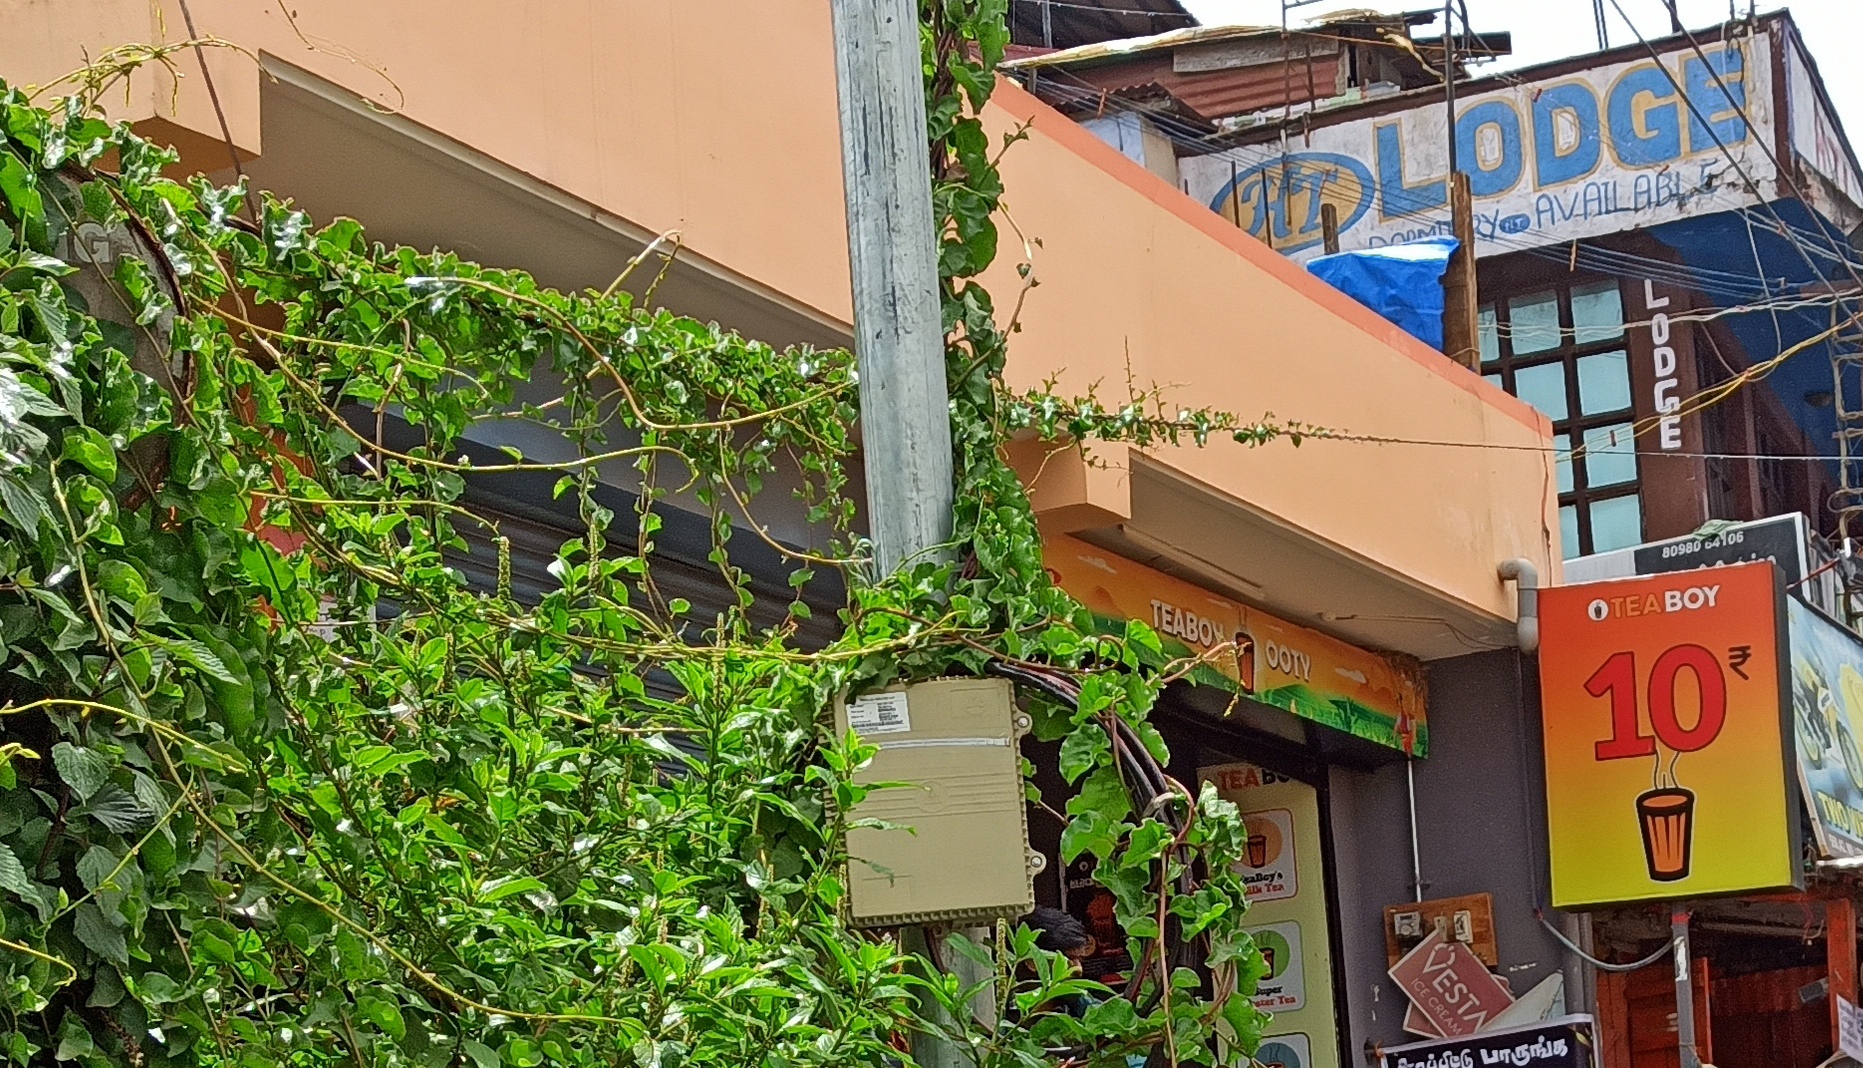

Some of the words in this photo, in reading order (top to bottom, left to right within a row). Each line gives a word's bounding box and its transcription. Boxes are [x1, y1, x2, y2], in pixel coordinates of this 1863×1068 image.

[1373, 40, 1752, 224] LODGE
[1644, 279, 1682, 449] LODGE
[1150, 599, 1225, 648] TEABOY
[1265, 639, 1311, 683] OOTY
[1610, 584, 1721, 619] TEABOY
[1411, 977, 1430, 998] ICE
[1428, 997, 1462, 1036] CREAM
[1422, 943, 1488, 1034] VESTA
